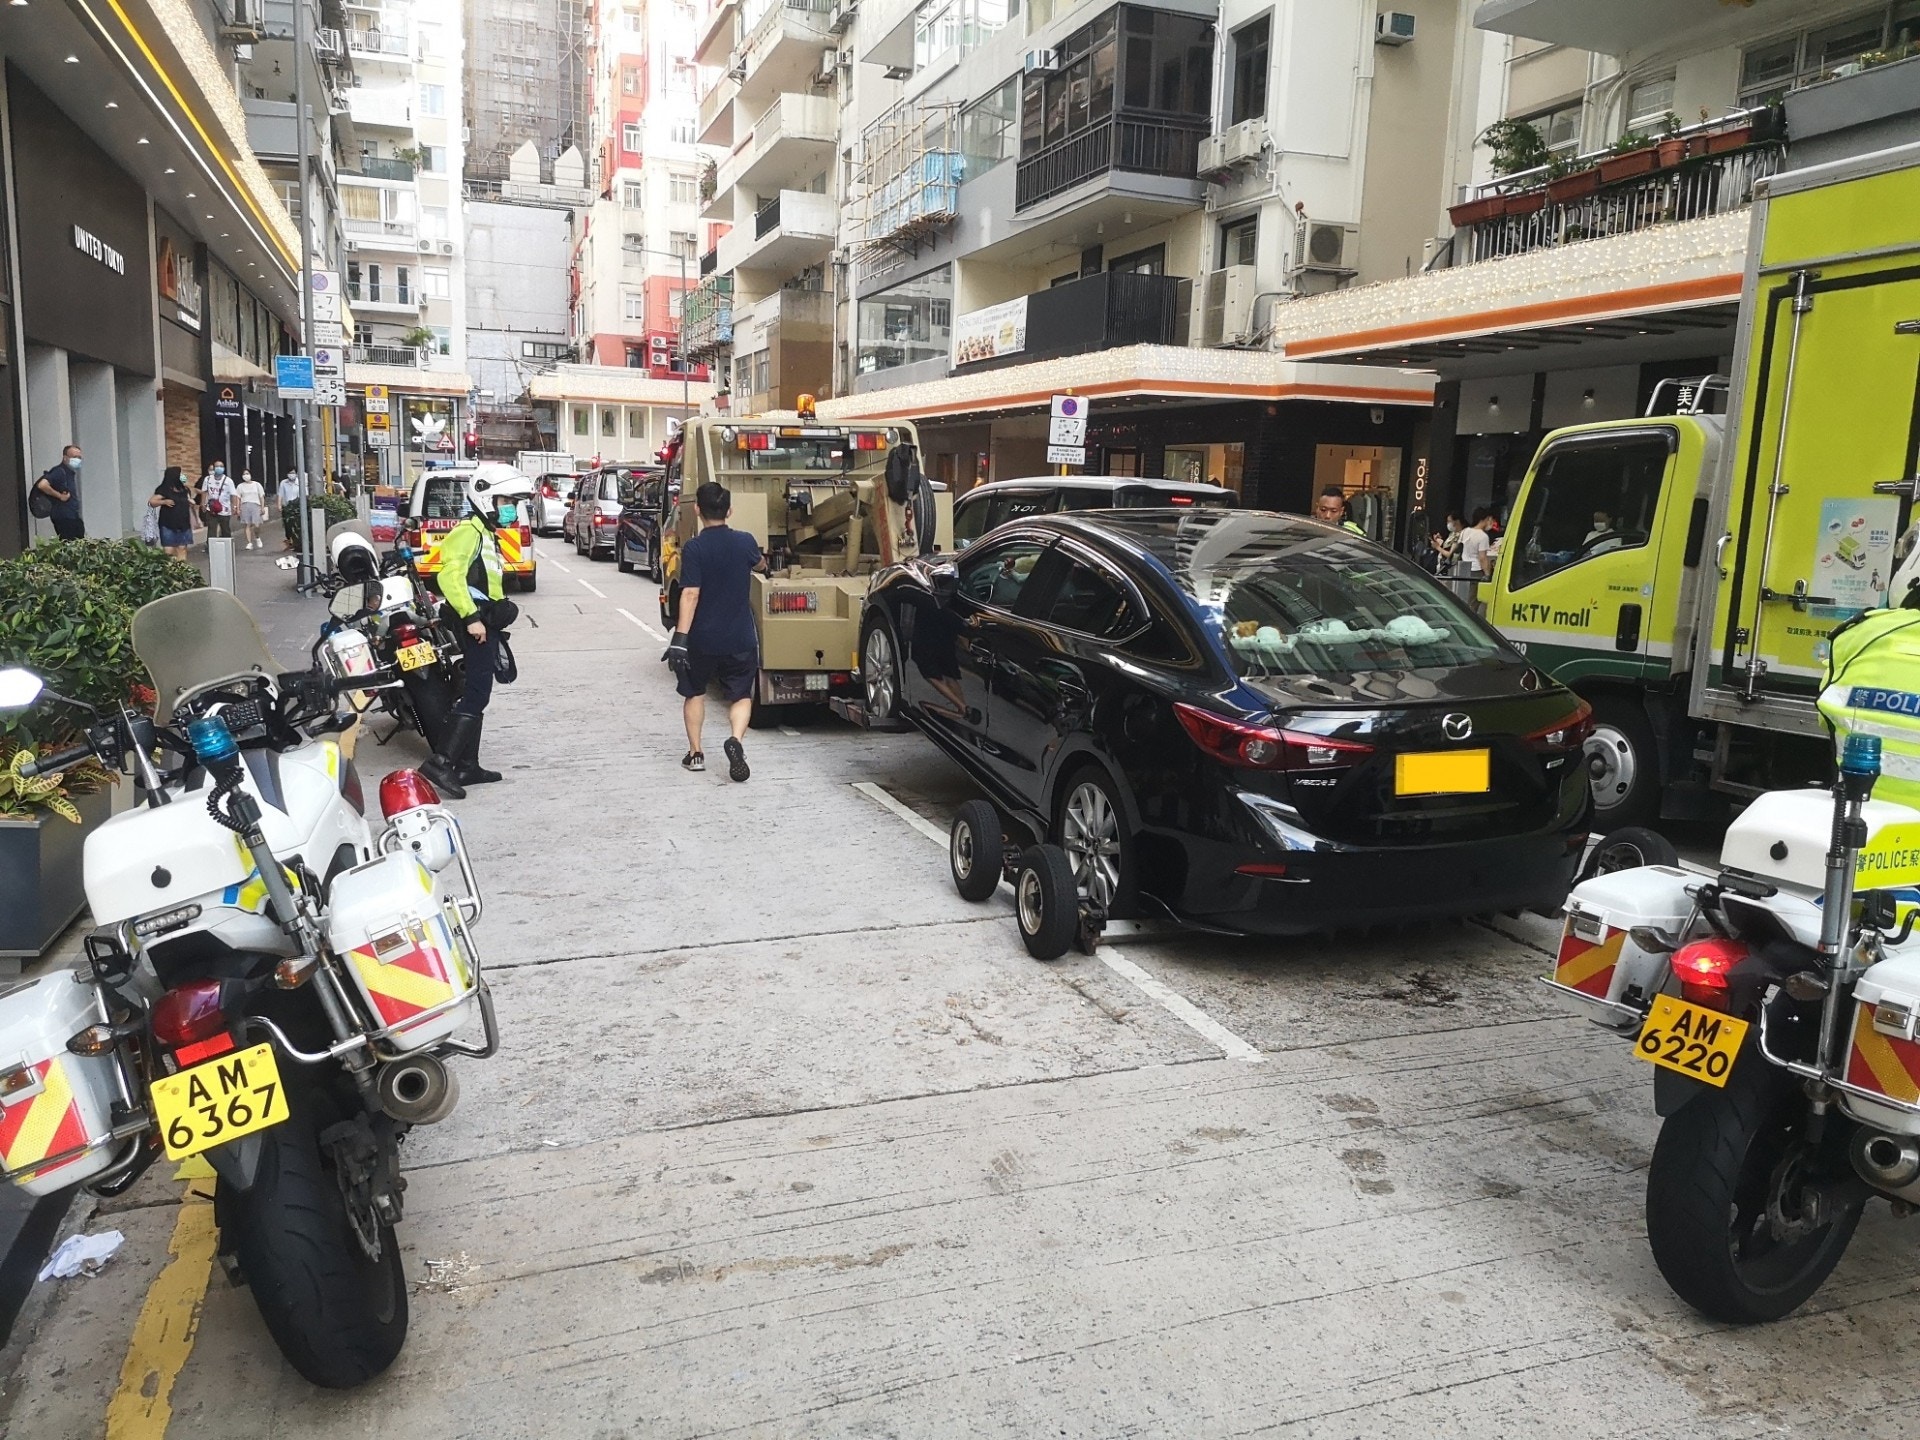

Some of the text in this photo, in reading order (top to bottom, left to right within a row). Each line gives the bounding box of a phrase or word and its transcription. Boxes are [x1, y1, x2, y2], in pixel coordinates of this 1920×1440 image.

[74, 224, 125, 276] UNITED TOKYO
[326, 295, 333, 305] 7
[327, 310, 334, 319] 7
[330, 380, 337, 389] 5
[216, 399, 240, 409] Ashley
[330, 394, 338, 404] 2
[1677, 386, 1693, 407] 美
[1074, 421, 1080, 430] 7
[1073, 434, 1079, 444] 7
[1415, 458, 1427, 500] FOOD
[428, 520, 459, 529] POLIC
[1511, 603, 1591, 628] HKTV mall
[1867, 849, 1908, 870] POLICE
[1670, 1009, 1722, 1046] AM
[1640, 1028, 1730, 1078] 6220
[188, 1058, 249, 1108] AM
[167, 1082, 277, 1150] 6367
